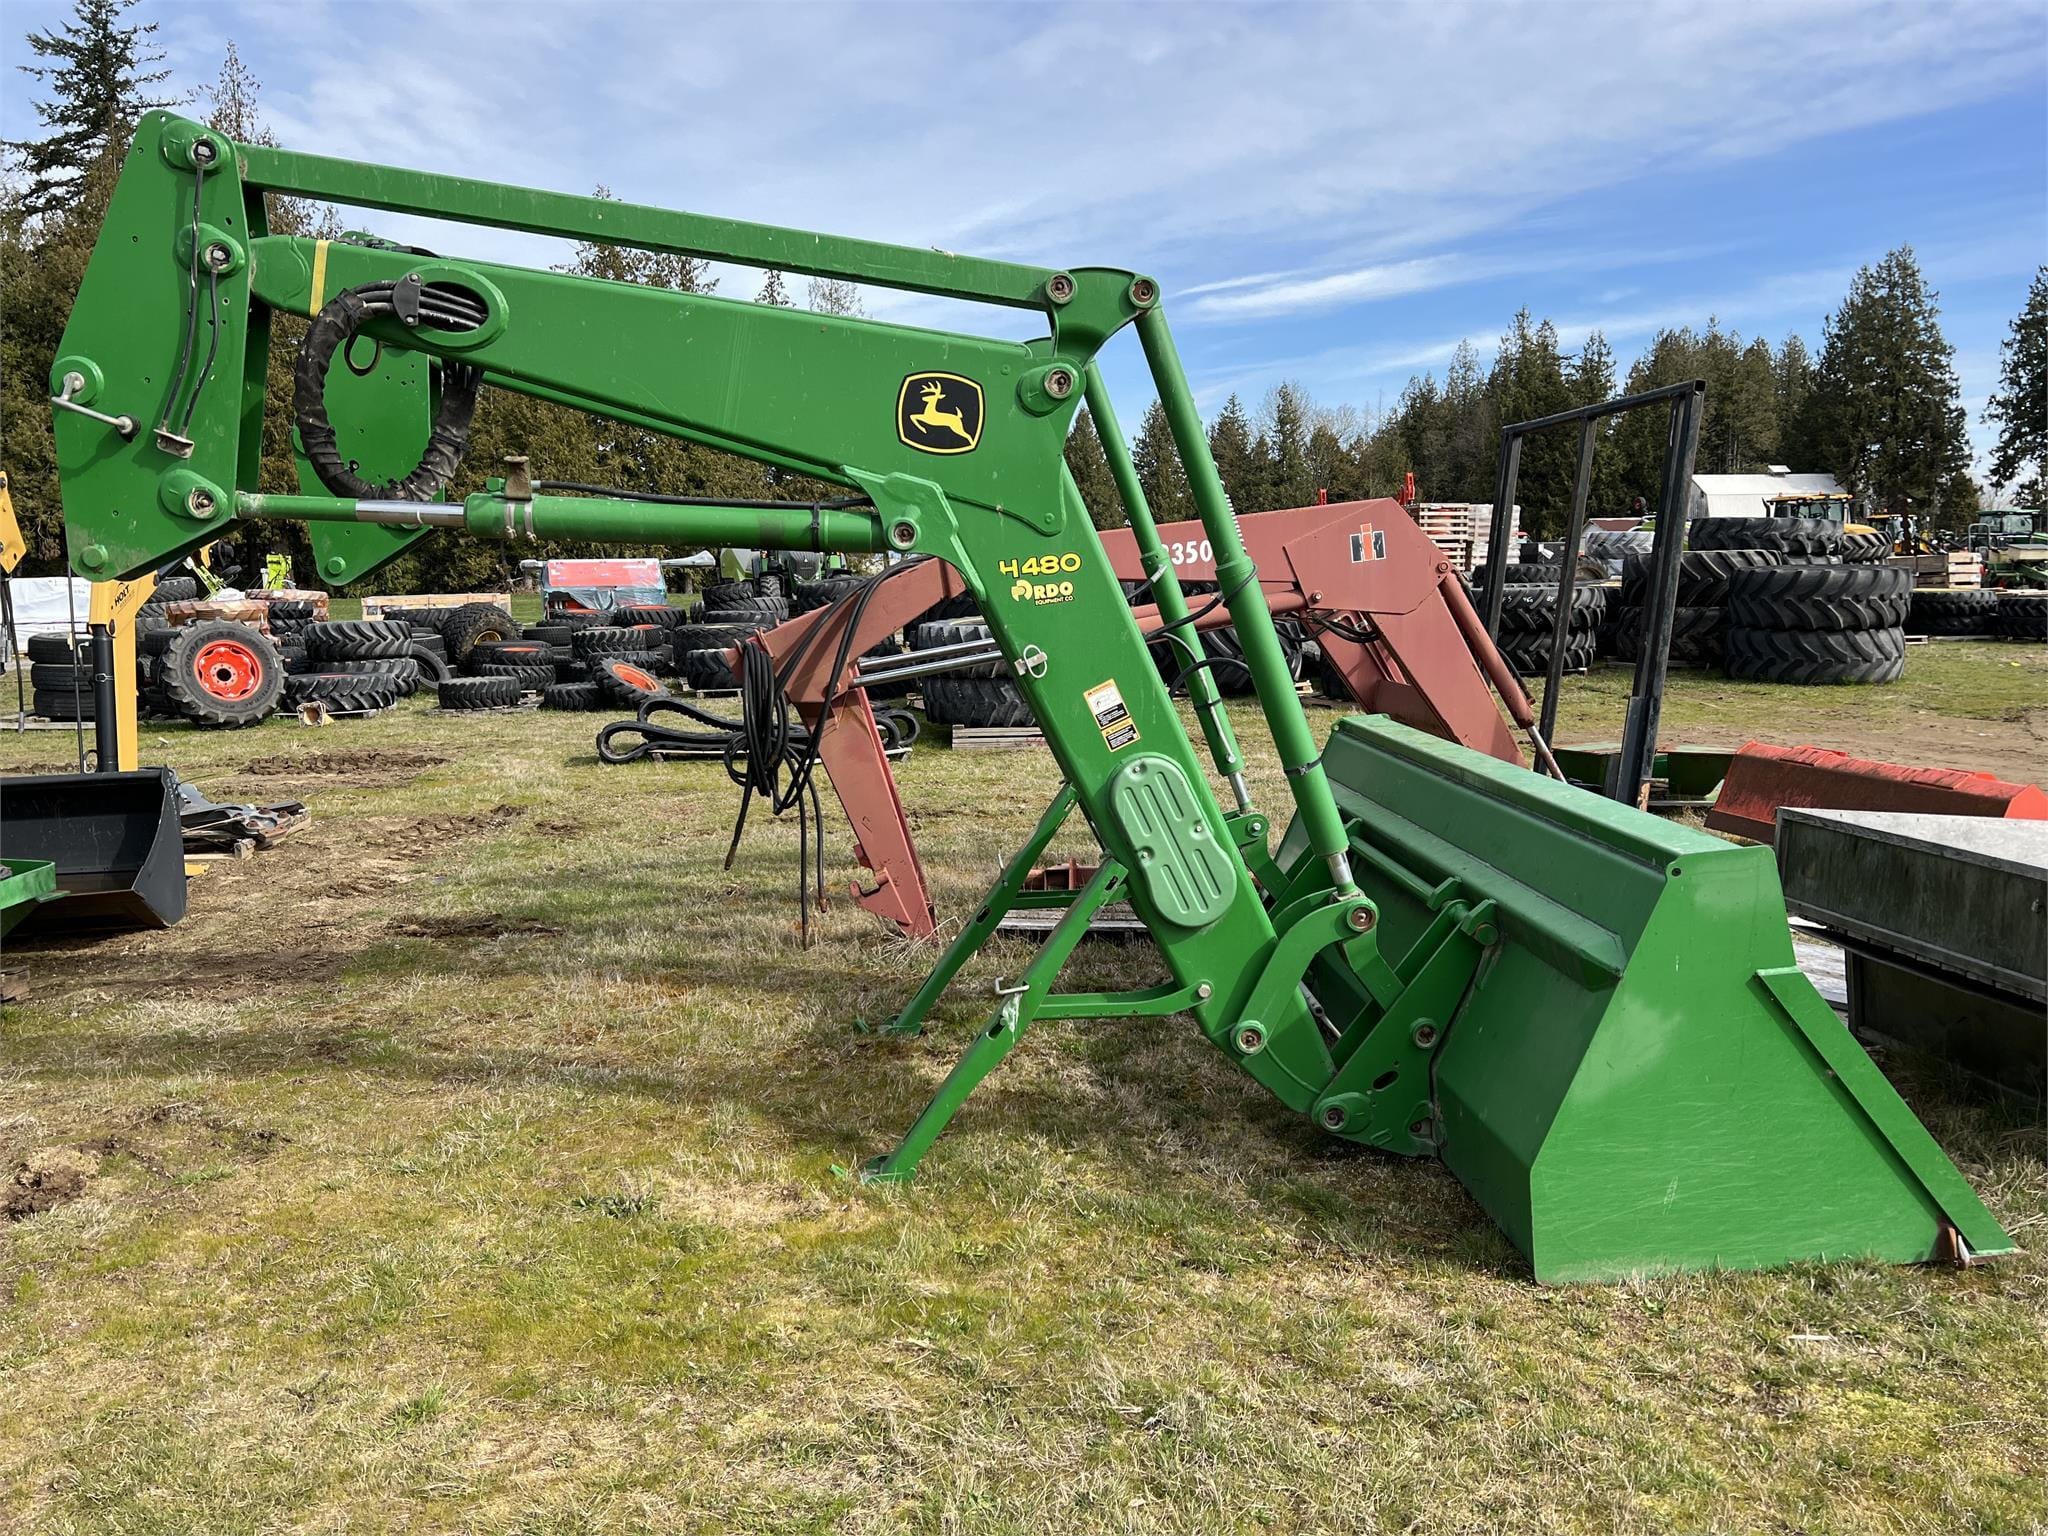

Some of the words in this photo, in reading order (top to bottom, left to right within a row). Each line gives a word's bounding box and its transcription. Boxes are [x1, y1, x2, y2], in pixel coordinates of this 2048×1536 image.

[998, 552, 1082, 578] H480
[1161, 539, 1214, 566] 350
[114, 584, 130, 607] HOLT
